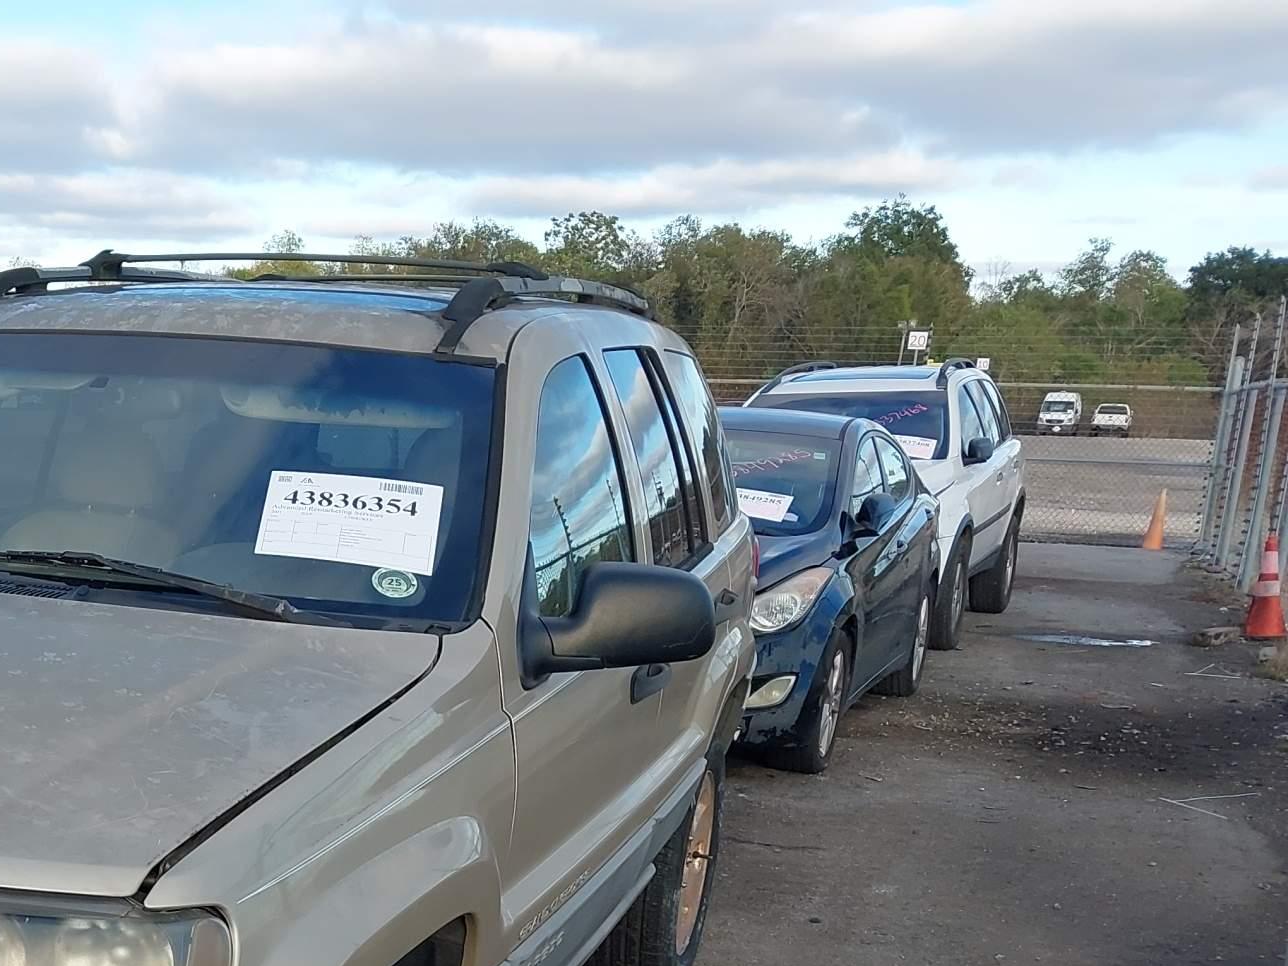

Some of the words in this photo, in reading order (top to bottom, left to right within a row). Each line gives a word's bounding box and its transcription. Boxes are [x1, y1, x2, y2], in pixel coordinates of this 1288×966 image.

[909, 335, 926, 348] 20
[283, 489, 419, 517] 43836354
[387, 578, 402, 587] 25
